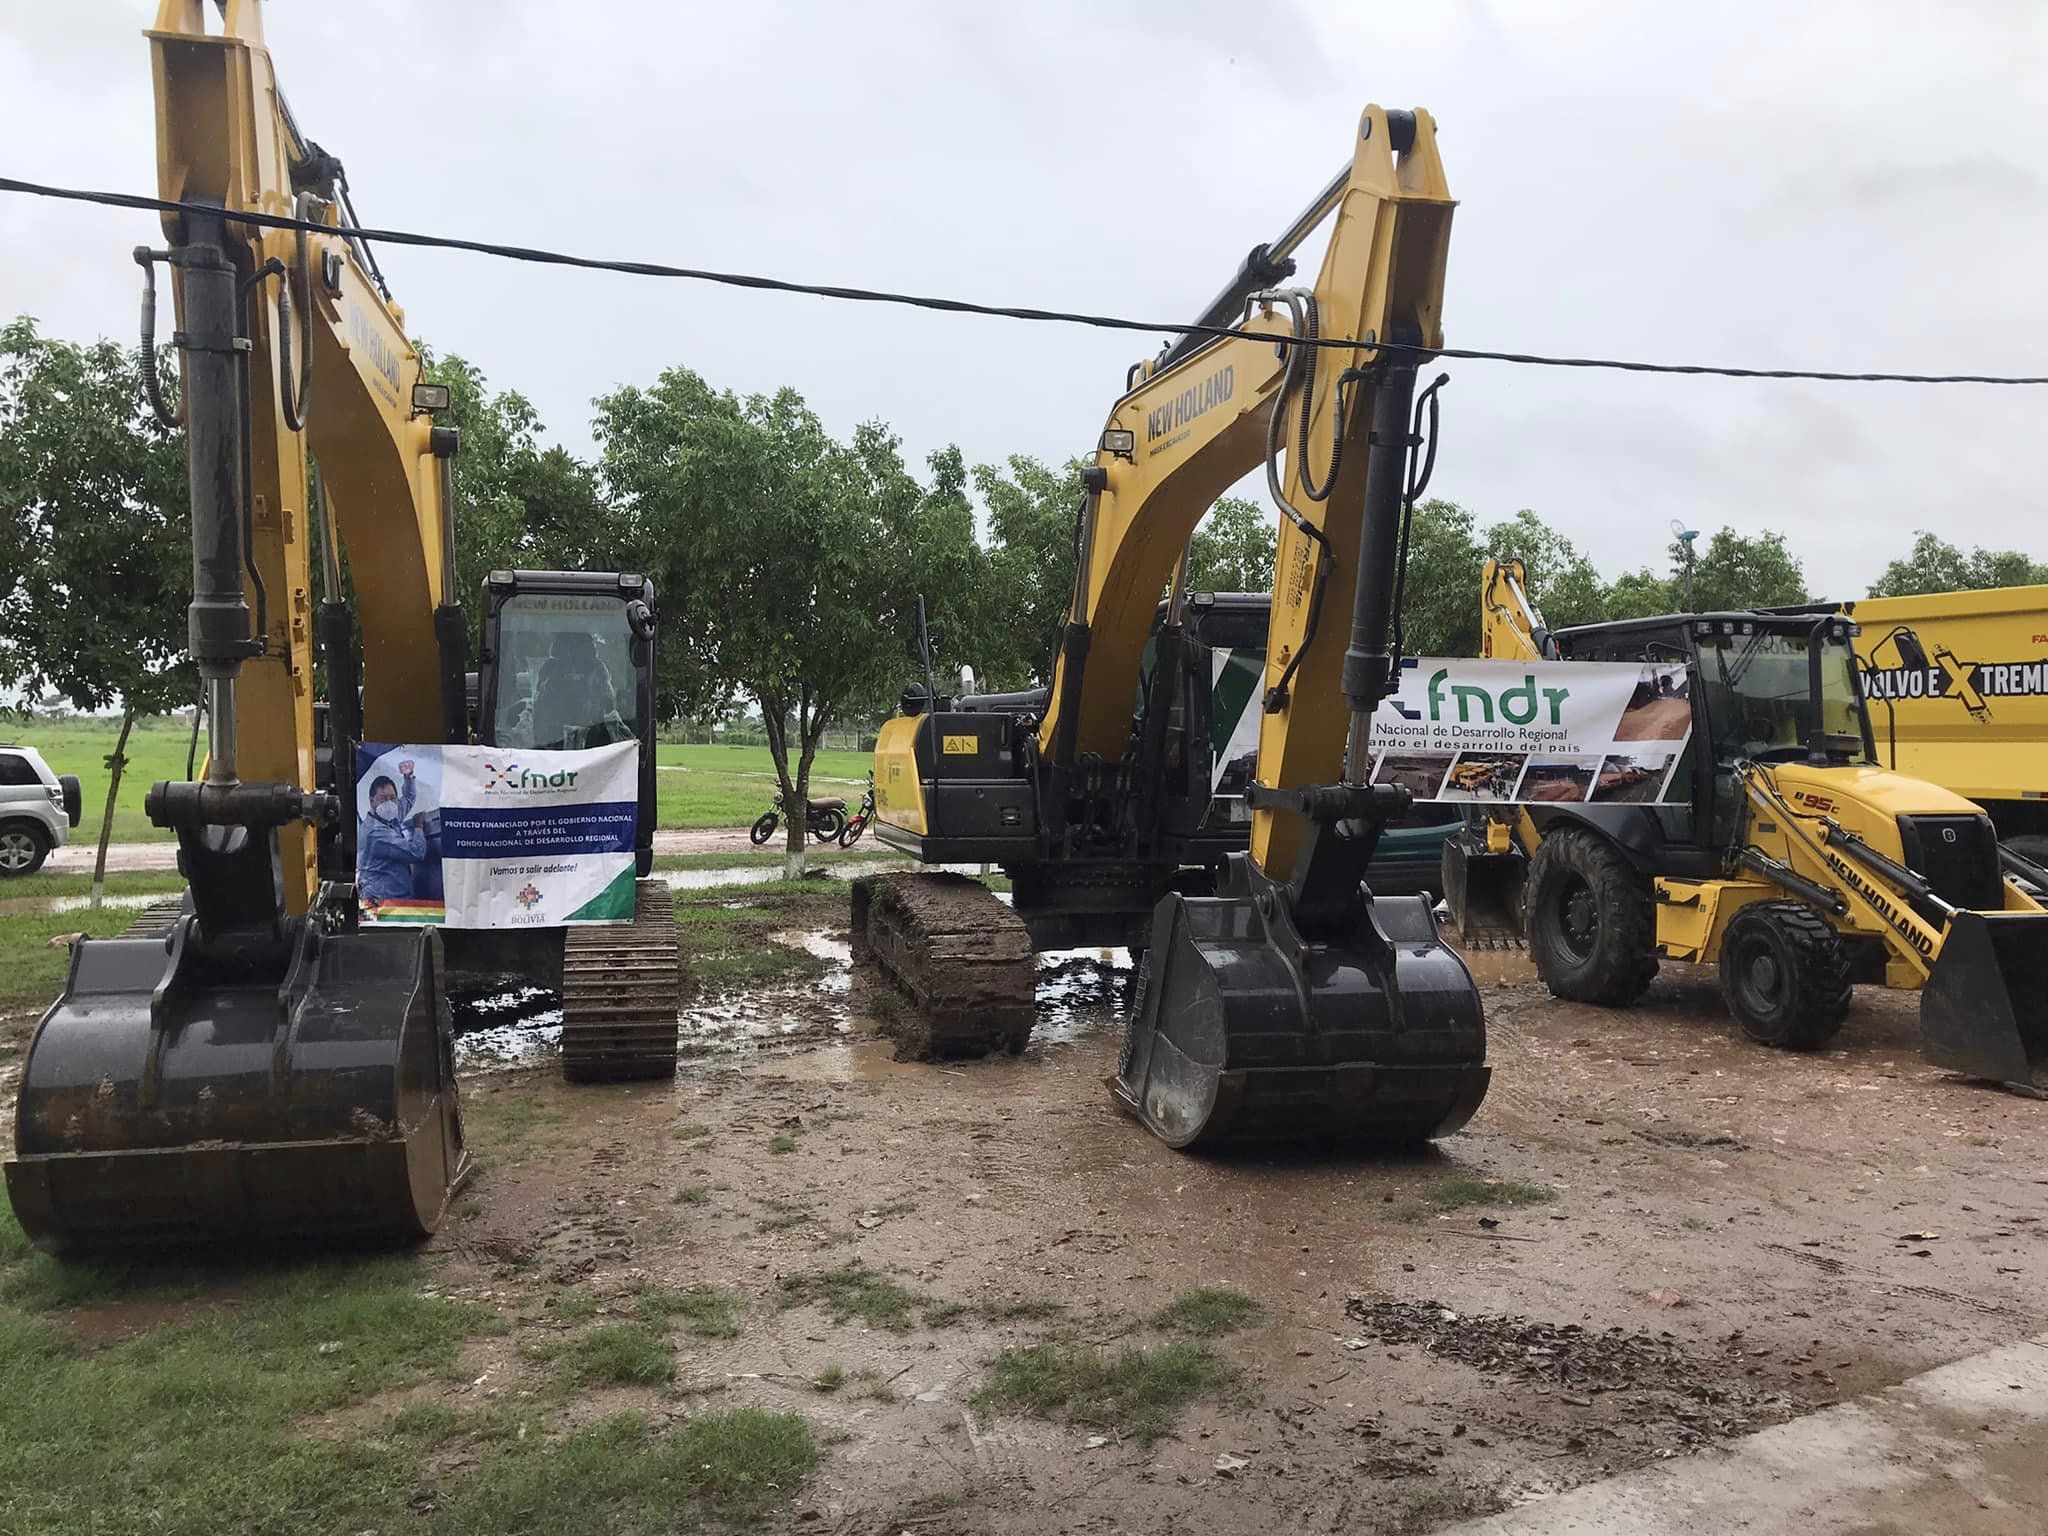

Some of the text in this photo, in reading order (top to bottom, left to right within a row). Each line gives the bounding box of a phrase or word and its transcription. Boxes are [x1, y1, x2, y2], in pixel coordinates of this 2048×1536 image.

[1148, 364, 1234, 442] NEW HOLLAND
[551, 599, 622, 611] HOLLAND
[1859, 669, 1923, 697] VOLVO
[1428, 667, 1570, 725] fndr
[1376, 722, 1568, 742] Nacional de Desarrollo Regional
[1414, 739, 1427, 748] el
[1434, 740, 1513, 750] desarrollo
[1520, 742, 1542, 752] del
[521, 768, 578, 789] fndr
[444, 820, 481, 829] PROYECTO
[482, 820, 529, 829] FINANCIADO
[558, 816, 597, 825] GOBIERNO
[598, 814, 632, 823] NACIONAL
[484, 839, 522, 847] NACIONAL
[536, 835, 584, 844] DESARROLLO
[585, 834, 618, 842] REGIONAL
[526, 864, 542, 874] salir
[543, 863, 578, 873] adelante!
[1827, 851, 1933, 956] NEW HOLLAND
[511, 913, 545, 924] BOLIVIA
